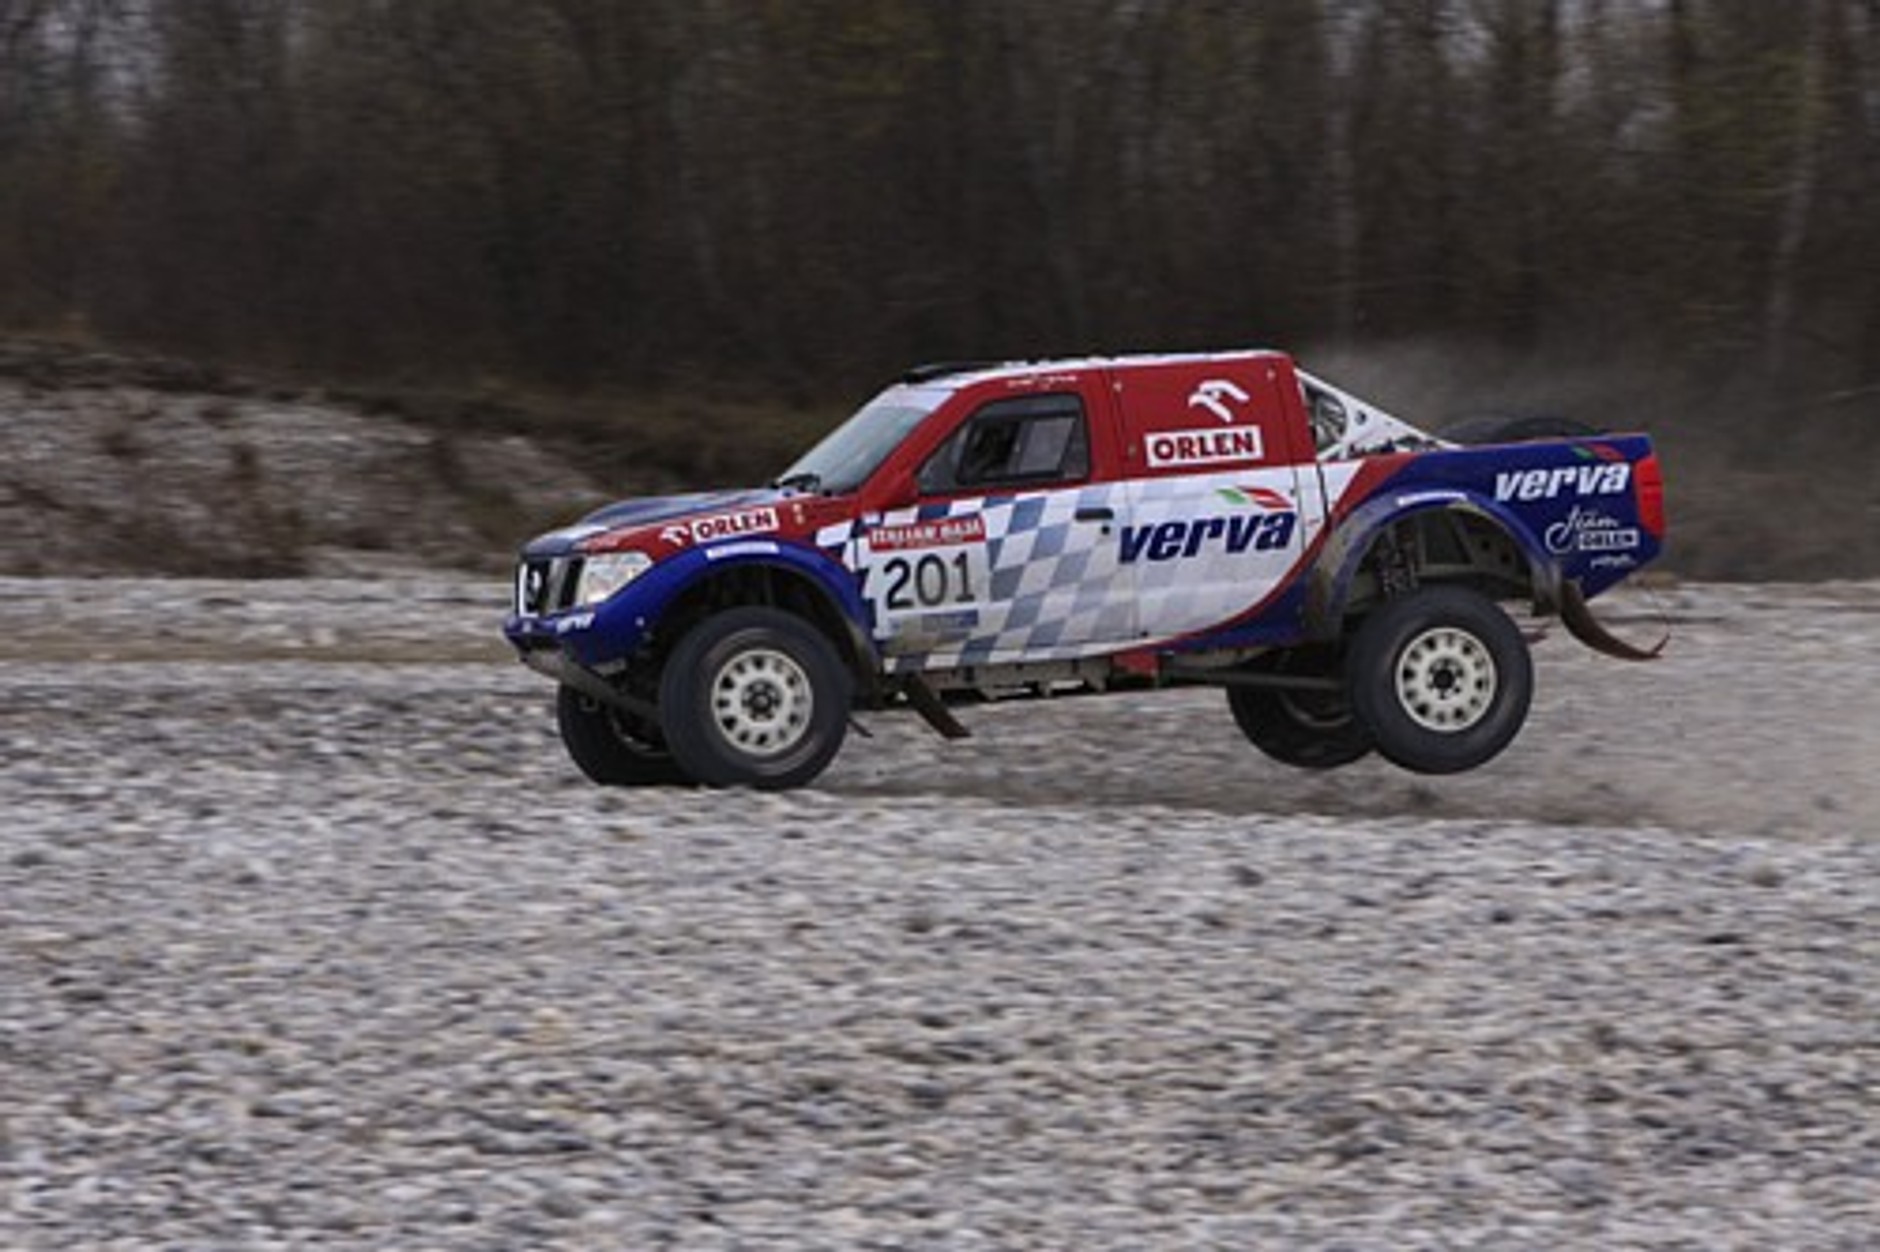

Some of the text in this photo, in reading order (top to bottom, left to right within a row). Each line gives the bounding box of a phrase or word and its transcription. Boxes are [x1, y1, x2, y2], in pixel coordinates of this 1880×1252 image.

[1153, 431, 1255, 461] ORLEN
[1494, 462, 1631, 502] verva
[698, 511, 774, 539] ORLEN
[1117, 511, 1297, 565] verva
[883, 551, 975, 610] 201
